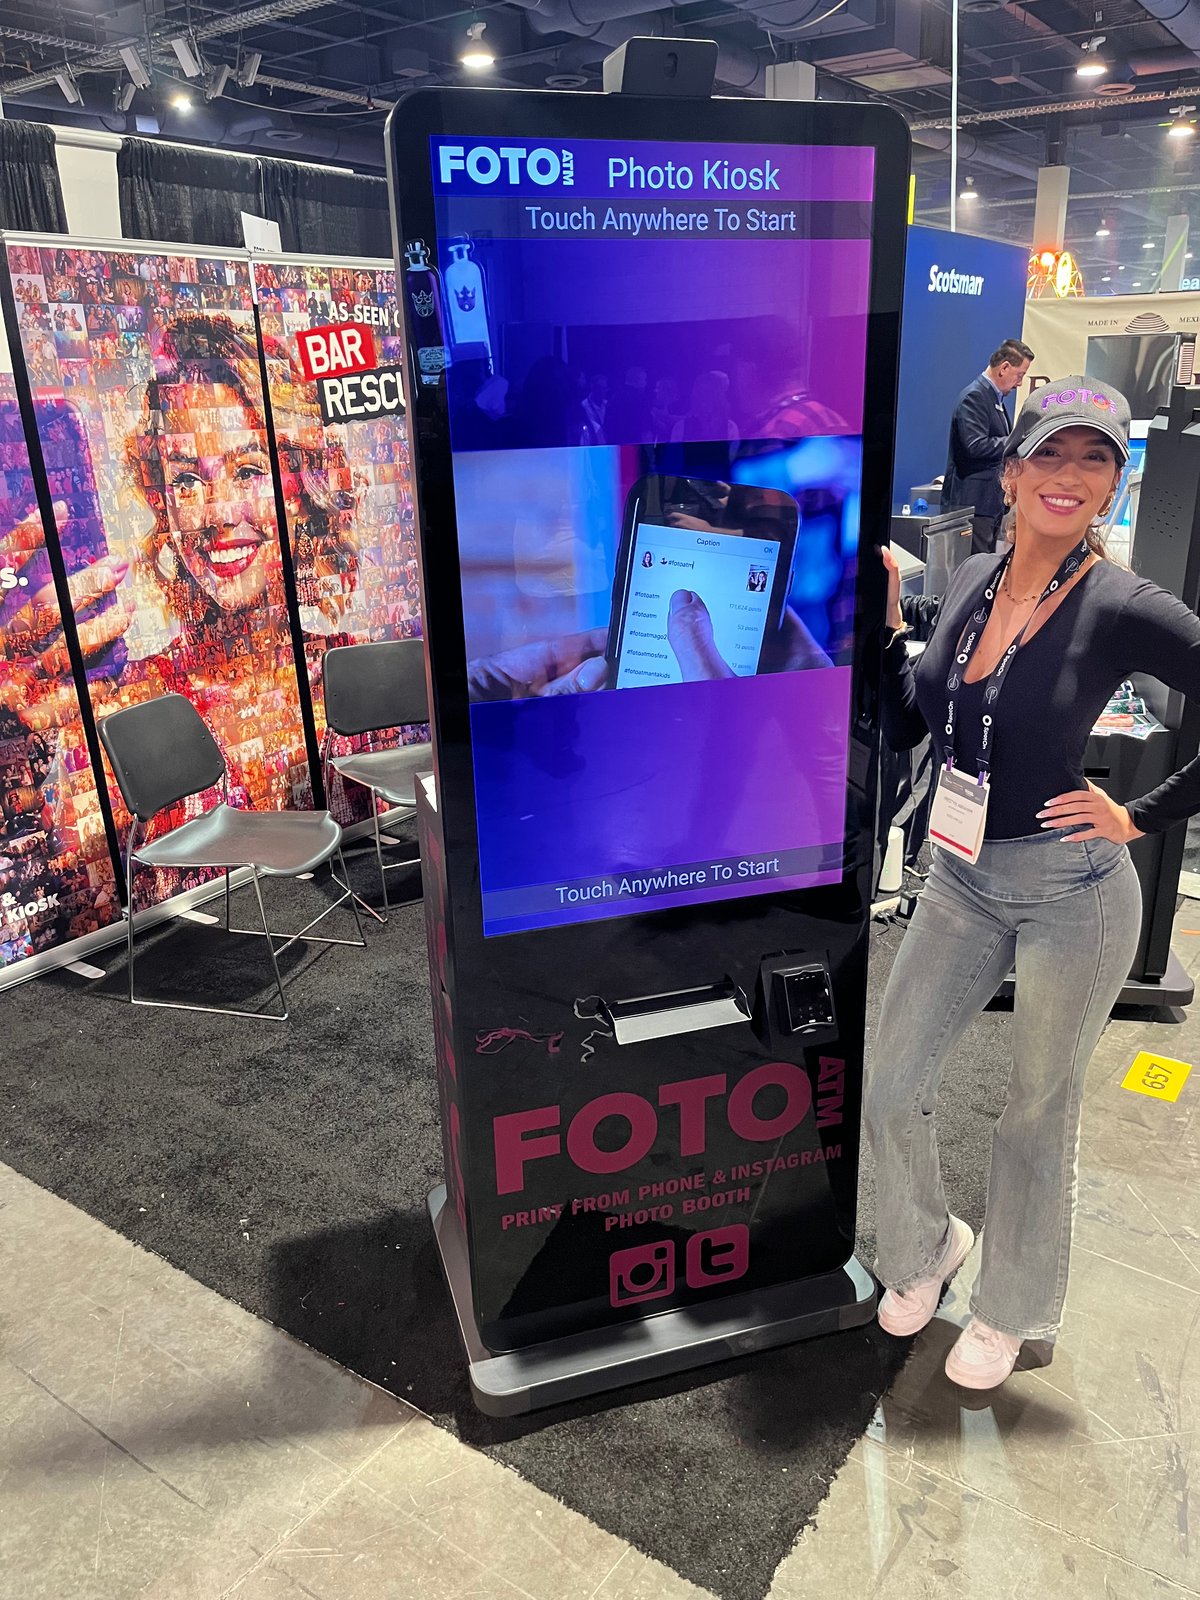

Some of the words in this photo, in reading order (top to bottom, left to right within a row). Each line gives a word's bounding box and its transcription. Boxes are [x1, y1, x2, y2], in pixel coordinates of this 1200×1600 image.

[439, 145, 560, 185] FOTO
[562, 149, 574, 186] ATM
[608, 157, 694, 189] Photo
[703, 160, 780, 190] Kiosk
[525, 206, 595, 230] Touch
[602, 207, 709, 236] Anywhere
[714, 208, 740, 231] To
[746, 208, 796, 231] Start
[928, 264, 984, 295] Scotsman
[329, 300, 349, 323] AS
[354, 304, 389, 326] SEEN
[305, 328, 366, 375] BAR
[1041, 387, 1110, 410] FOTO
[696, 537, 720, 547] Caption
[763, 546, 774, 554] OK
[634, 590, 660, 600] #fotoatm
[632, 610, 657, 619] #fotoatm
[963, 631, 976, 653] SpotOn
[556, 881, 613, 903] Touch
[618, 870, 707, 895] Anywhere
[710, 864, 733, 881] To
[737, 857, 779, 877] Start
[6, 893, 60, 924] KIOSK
[1141, 1063, 1172, 1090] 657
[493, 1062, 812, 1195] FOTO
[816, 1055, 846, 1129] ATM
[501, 1203, 562, 1230] PRINT
[571, 1188, 630, 1215] FROM
[638, 1172, 705, 1201] PHONE
[712, 1168, 727, 1184] &
[731, 1143, 842, 1182] INSTAGRAM
[604, 1203, 673, 1232] PHOTO
[682, 1186, 751, 1215] BOOTH
